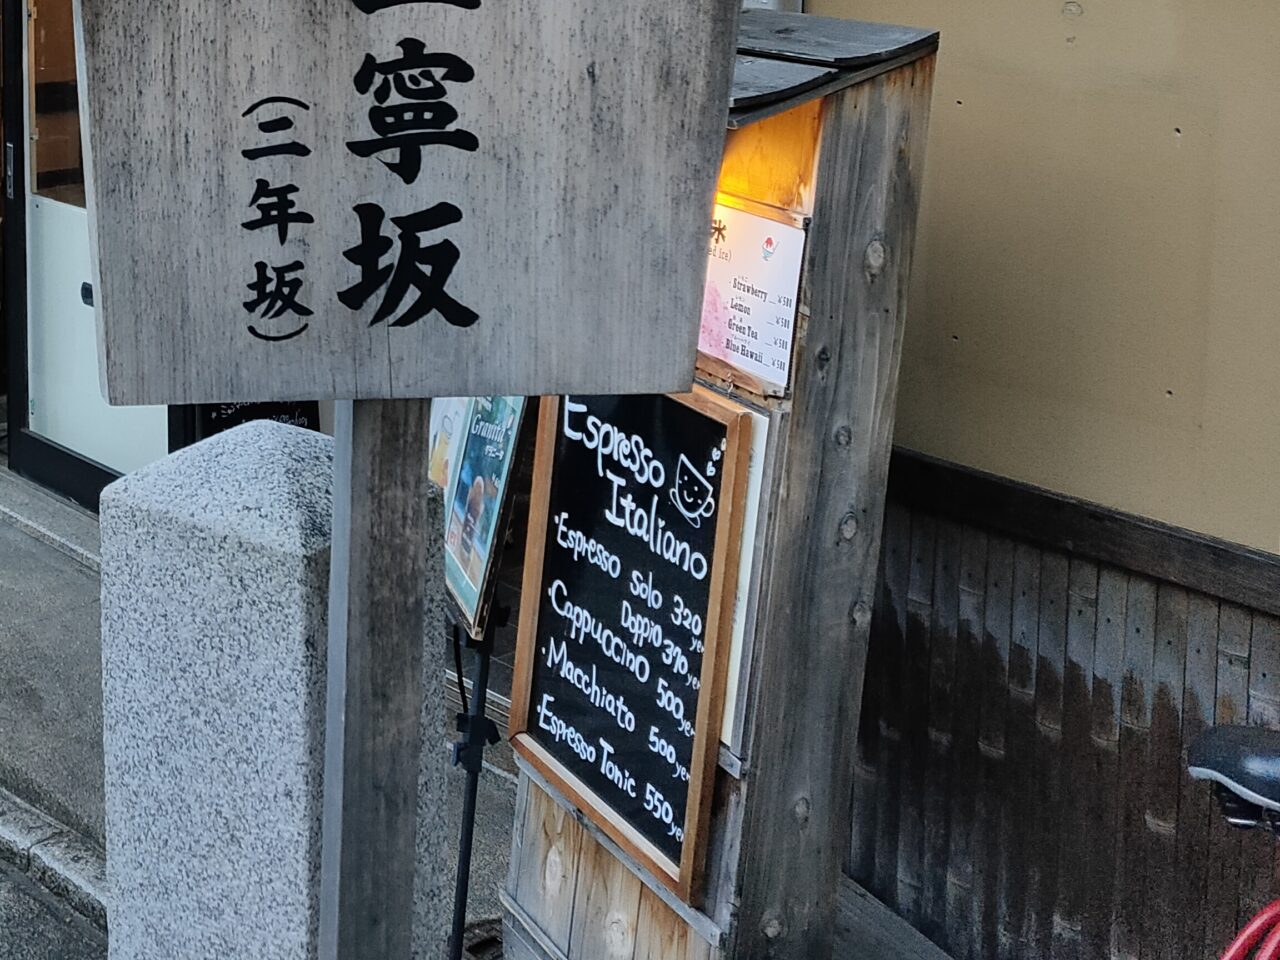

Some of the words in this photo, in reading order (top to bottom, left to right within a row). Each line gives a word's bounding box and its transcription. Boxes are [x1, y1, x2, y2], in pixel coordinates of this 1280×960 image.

[727, 318, 746, 336] Green
[747, 325, 759, 340] Tea
[730, 297, 751, 316] Lemon
[732, 277, 769, 303] Strawberry
[725, 338, 740, 354] Blue
[740, 343, 764, 364] Hawaii
[563, 394, 666, 488] Espresso
[605, 469, 708, 580] Italiano
[556, 512, 621, 578] Espresso
[671, 594, 703, 636] 320
[551, 579, 651, 683] Cappuccino
[655, 677, 684, 720] 500
[621, 600, 663, 648] Doppio
[546, 636, 636, 732] Macchiato
[648, 725, 677, 764] 500
[538, 693, 597, 763] Espresso
[599, 737, 637, 798] Tonic
[642, 782, 674, 824] 550
